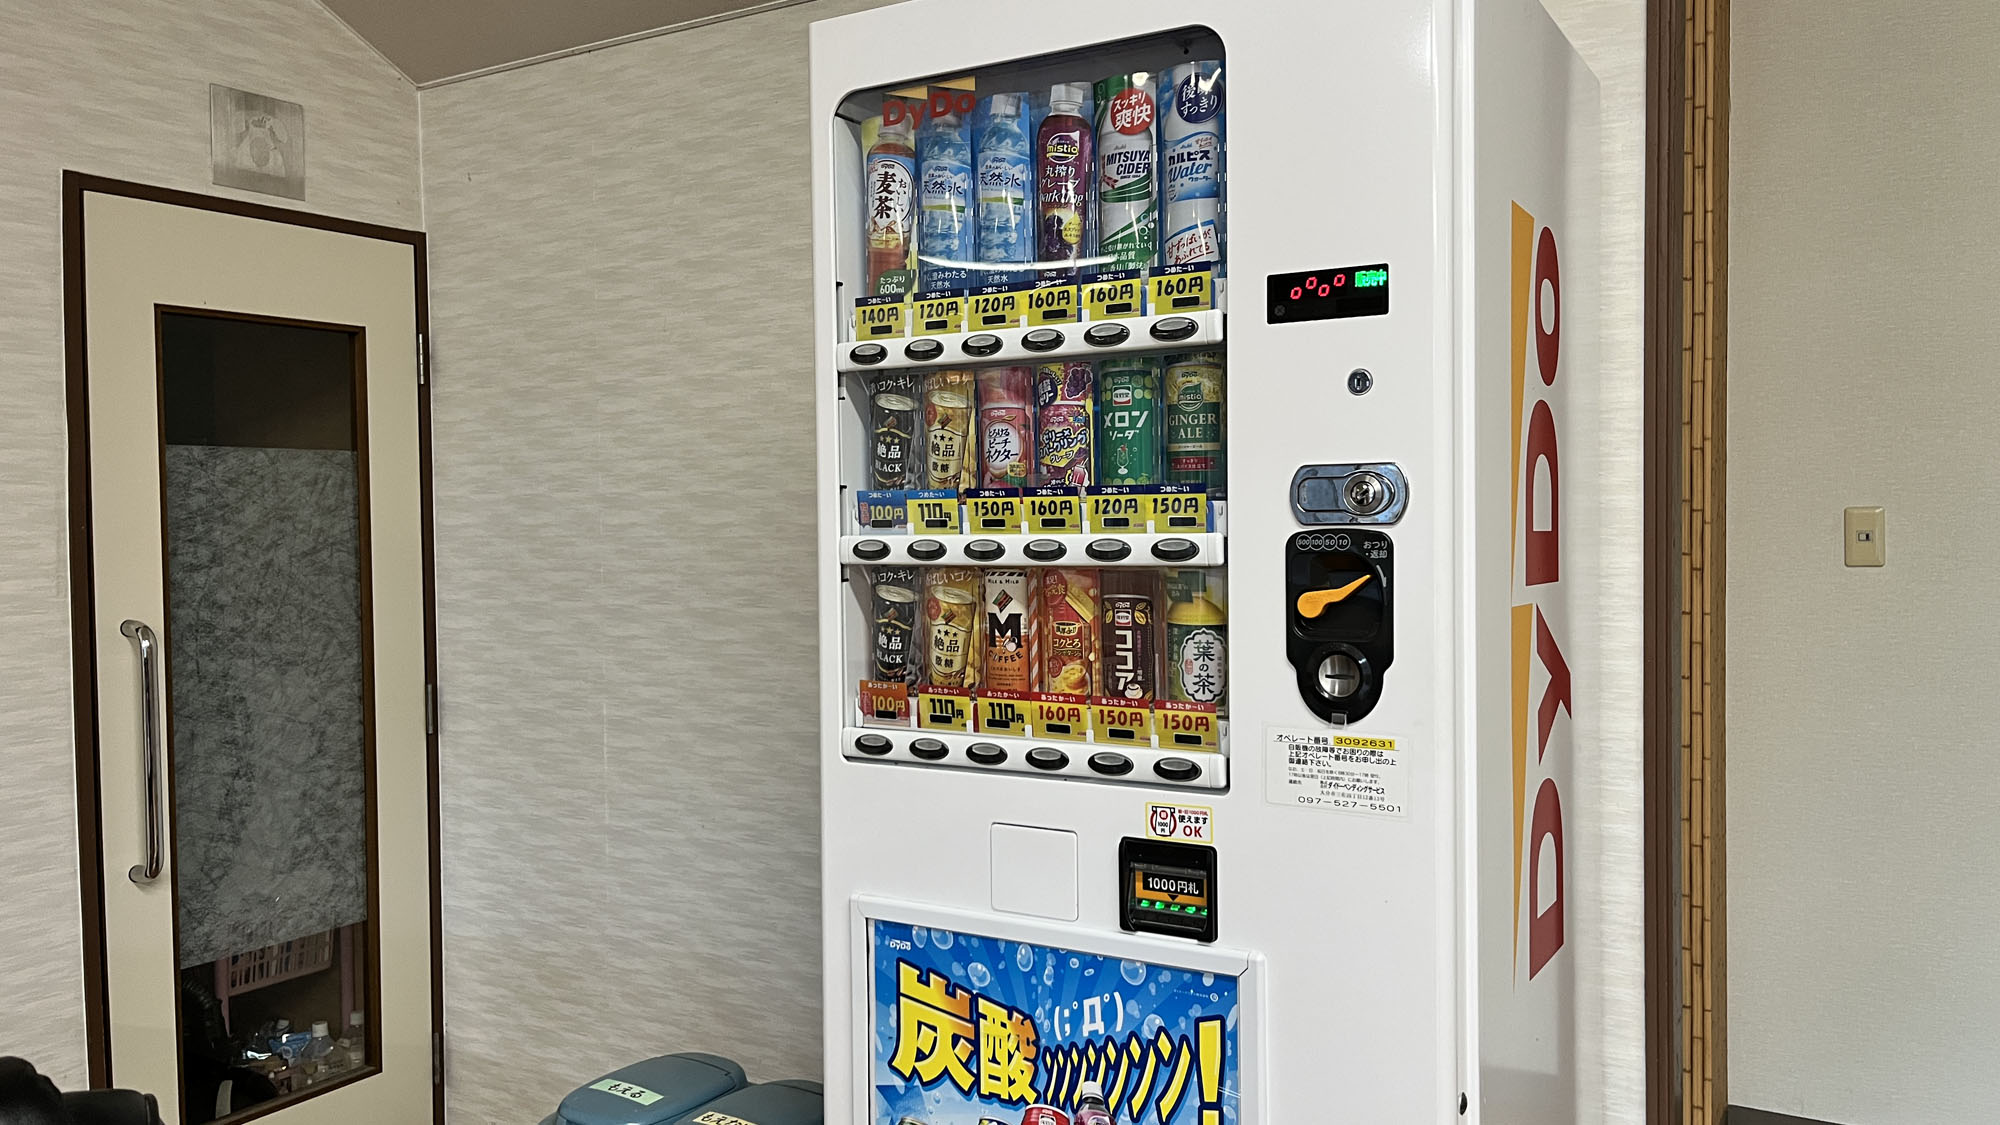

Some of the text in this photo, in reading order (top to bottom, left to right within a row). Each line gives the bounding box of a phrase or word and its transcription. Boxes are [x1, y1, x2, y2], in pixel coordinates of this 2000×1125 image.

[1113, 91, 1145, 110] スッキリ
[1181, 95, 1218, 118] すっきり
[881, 90, 976, 131] DyDo
[1115, 107, 1151, 133] 爽快
[1106, 150, 1151, 166] MITSUYA
[1168, 149, 1211, 166] カルピス
[1116, 162, 1151, 175] CIDER
[1168, 162, 1213, 183] Water
[922, 180, 963, 195] 天然水
[979, 172, 1021, 187] 天然水
[874, 170, 897, 219] 麦茶
[880, 275, 905, 284] たっぷり
[987, 274, 1008, 284] 天然水
[1157, 275, 1203, 297] 160円
[880, 283, 906, 294] 600ml
[1090, 283, 1134, 304] 160円
[975, 295, 1015, 315] 120円
[1028, 289, 1071, 309] 160円
[862, 306, 899, 325] 140円
[920, 300, 959, 320] 120円
[1103, 410, 1149, 429] メロン
[1168, 413, 1218, 427] GINGER
[1109, 430, 1139, 441] ソーダ
[1178, 427, 1203, 440] ALE
[988, 437, 1011, 449] ピーチ
[985, 449, 1019, 463] ネクター
[870, 505, 904, 521] 100円
[973, 500, 1015, 517] 150円
[1030, 499, 1073, 516] 160円
[1094, 498, 1138, 515] 120円
[1152, 497, 1199, 514] 150円
[1363, 539, 1388, 549] おつり
[988, 612, 1022, 649] M
[934, 634, 960, 653] 絶品
[1053, 637, 1081, 648] コクとろ
[1115, 629, 1135, 691] ココア
[1192, 639, 1216, 695] 葉の茶
[872, 694, 906, 712] 100円
[1038, 705, 1081, 723] 160円
[1099, 709, 1144, 727] 150円
[1163, 713, 1209, 732] 150円
[1336, 736, 1393, 748] 3092631
[1178, 815, 1208, 825] 使えます
[1183, 825, 1203, 838] OK
[1147, 876, 1199, 895] 1000円札
